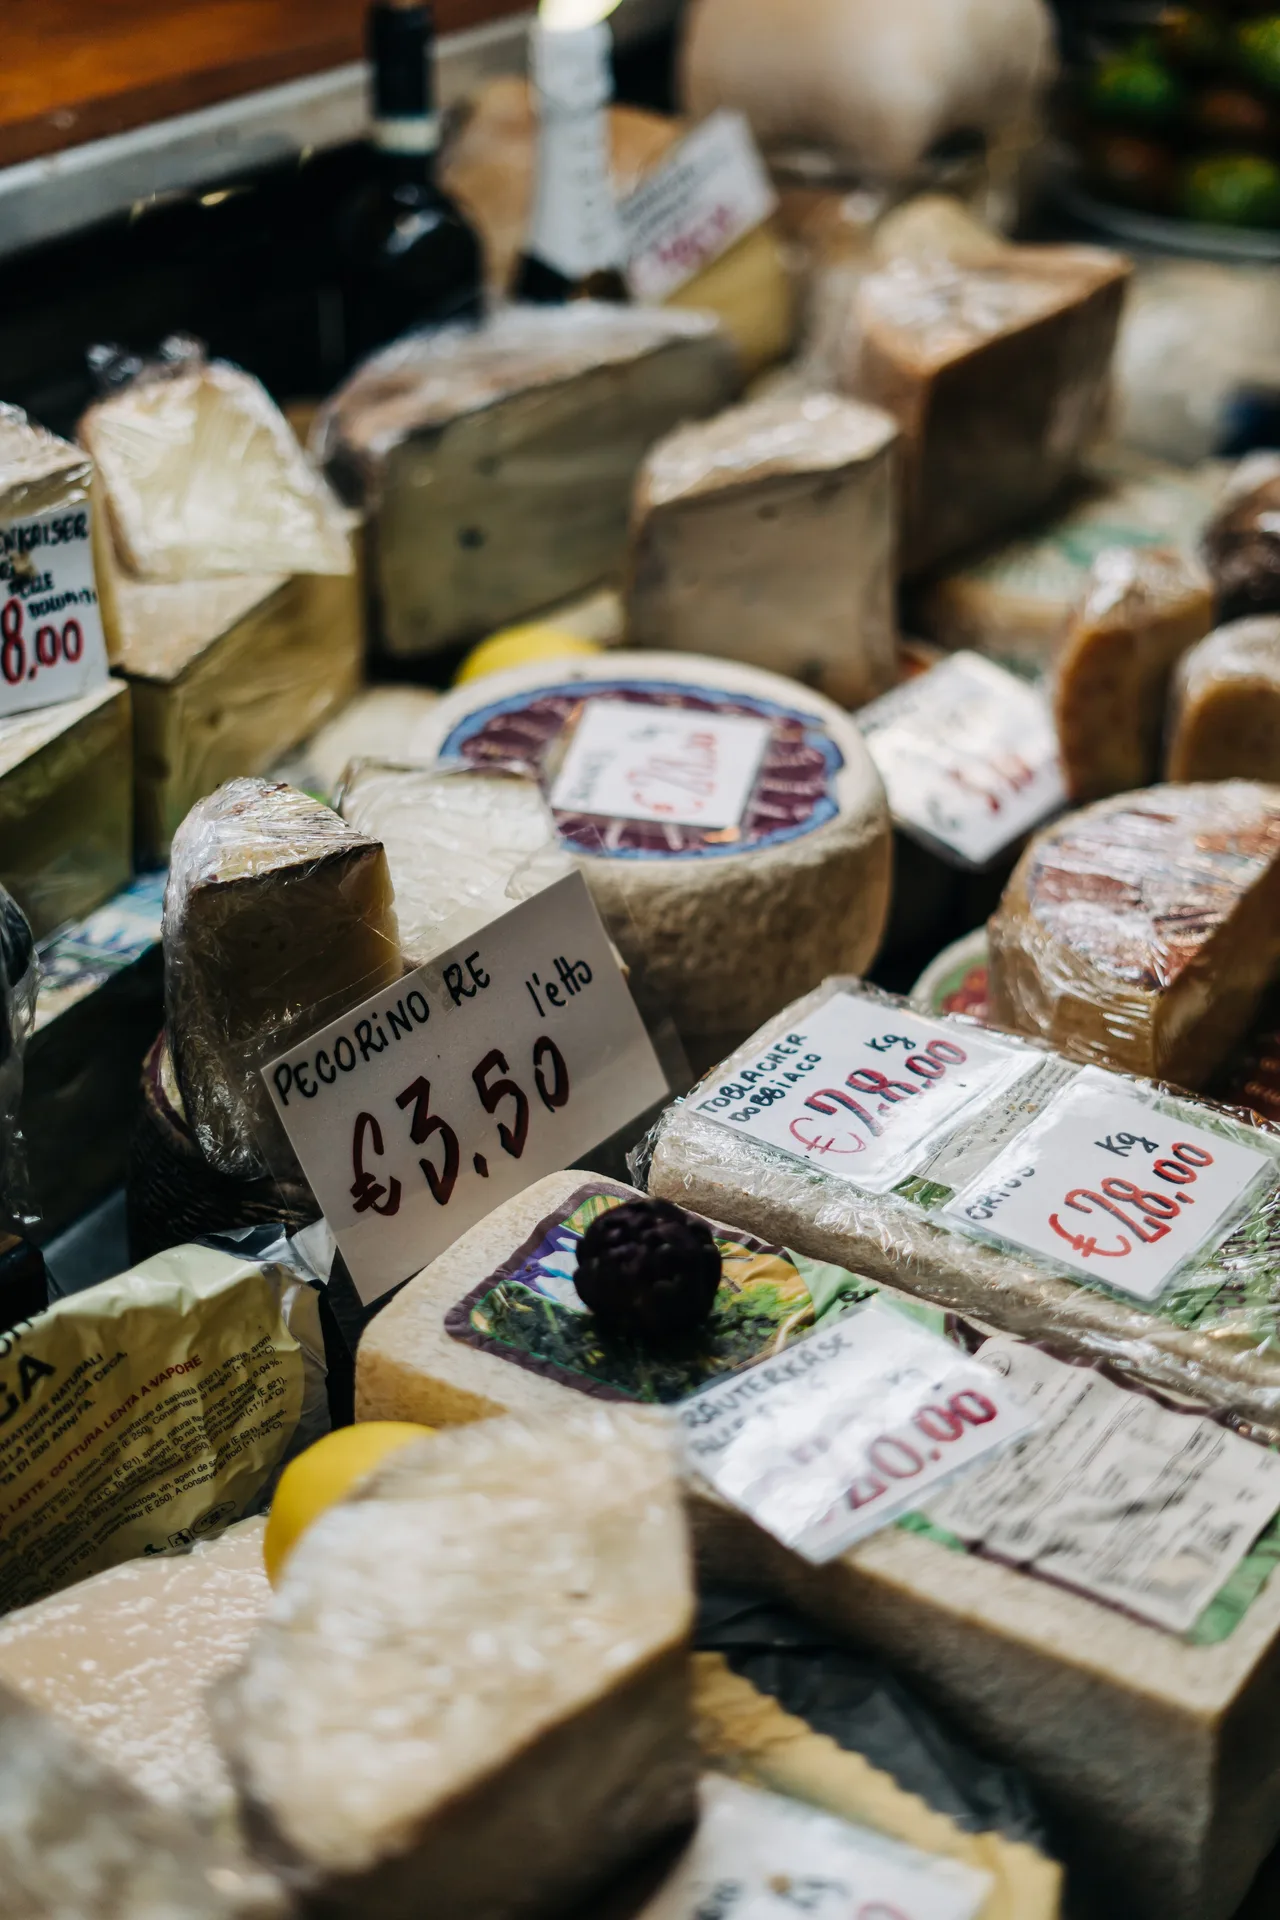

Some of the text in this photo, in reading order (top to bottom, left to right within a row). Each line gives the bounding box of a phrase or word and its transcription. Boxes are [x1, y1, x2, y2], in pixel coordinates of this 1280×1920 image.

[273, 951, 491, 1105] PECORINO RE
[696, 1033, 807, 1113] TOBLACHER
[728, 1054, 822, 1122] DOBBIACO
[51, 1353, 102, 1404] NATURALI
[154, 1403, 163, 1412] di
[251, 1333, 271, 1352] aromi
[25, 1380, 91, 1445] REPUBBLICA
[50, 1426, 102, 1477] COTTURA
[103, 1393, 139, 1428] LENTA
[138, 1384, 151, 1396] A
[149, 1355, 202, 1388] VAPORE
[152, 1397, 198, 1425] Conservare
[167, 1418, 191, 1438] natural
[172, 1434, 184, 1445] Do
[184, 1426, 196, 1437] not
[15, 1458, 30, 1473] DI
[29, 1439, 51, 1459] 200
[50, 1414, 79, 1440] ANNI
[174, 1486, 182, 1494] A
[225, 1444, 243, 1460] froid
[174, 1468, 196, 1485] agent
